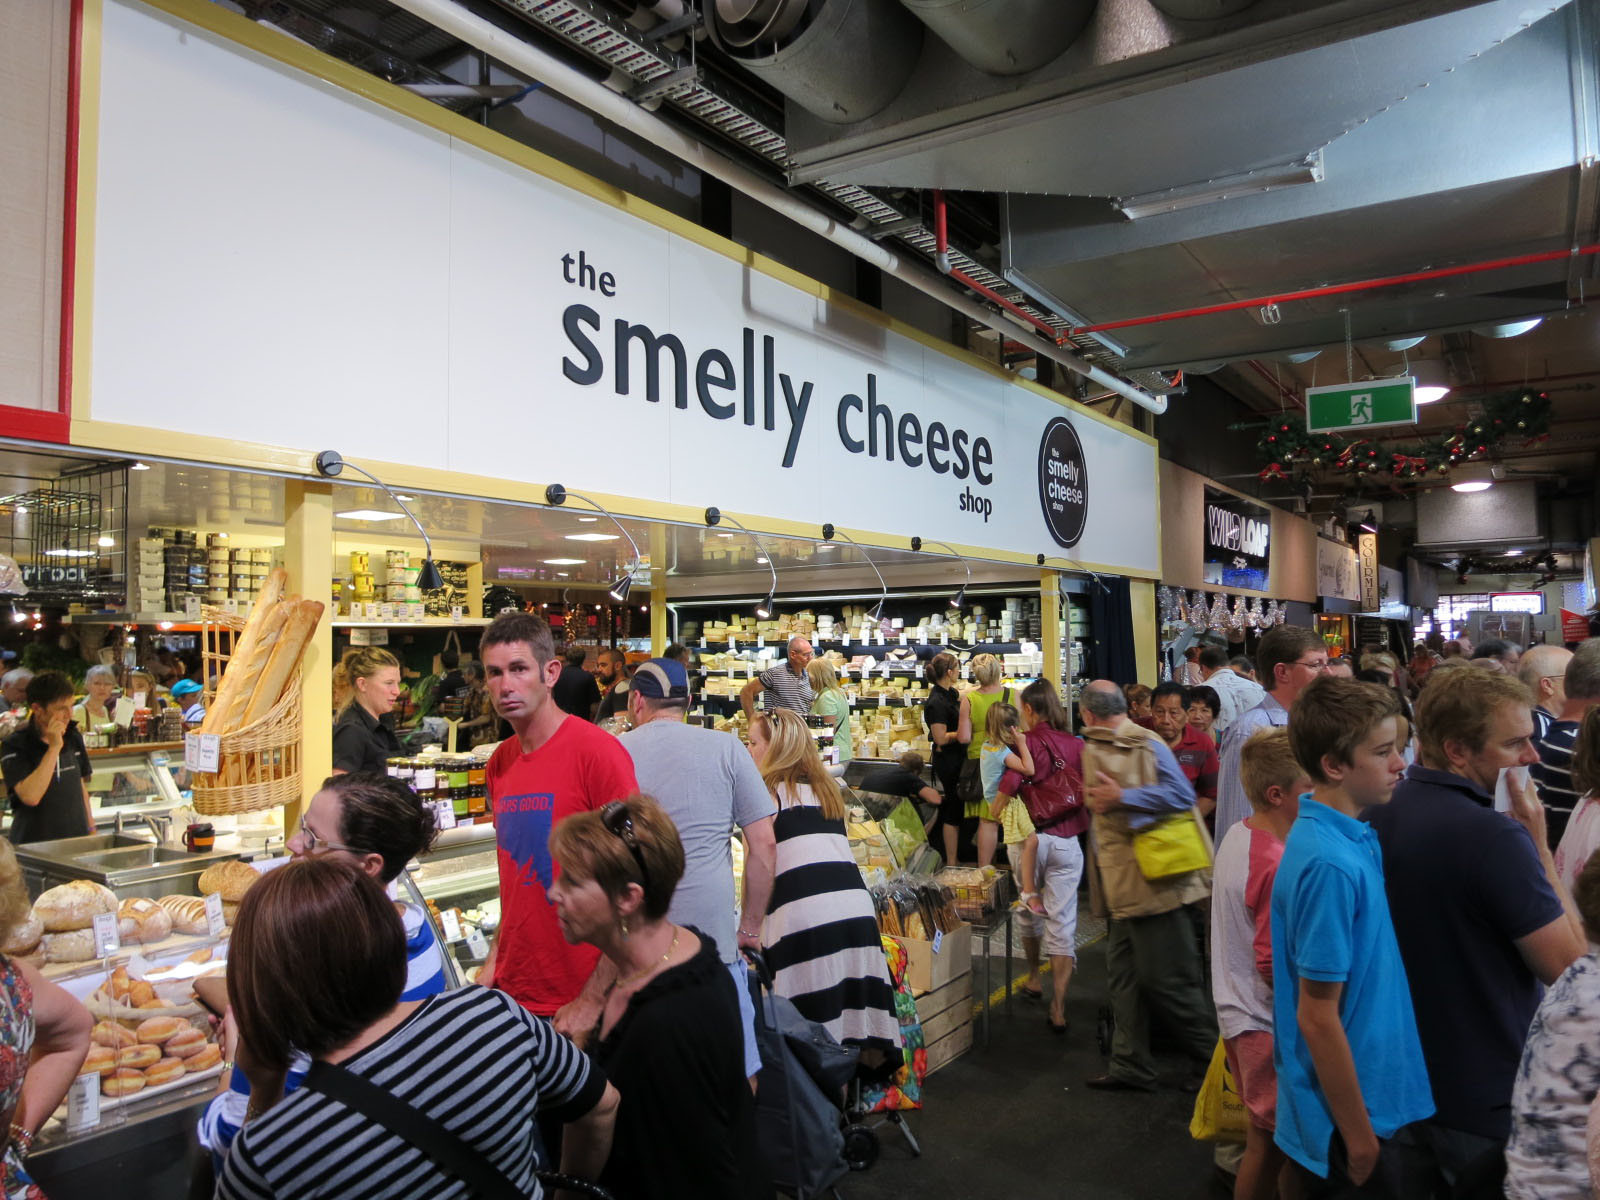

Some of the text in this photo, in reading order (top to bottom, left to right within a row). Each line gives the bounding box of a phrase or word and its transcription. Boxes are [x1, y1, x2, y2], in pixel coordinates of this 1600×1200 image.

[561, 250, 616, 297] the
[562, 303, 993, 486] smelly cheese
[1051, 447, 1060, 458] the
[1048, 459, 1079, 486] smelly
[959, 485, 993, 523] shop
[1048, 478, 1083, 505] cheese
[1052, 501, 1064, 512] shop
[1362, 537, 1375, 608] GOURMET
